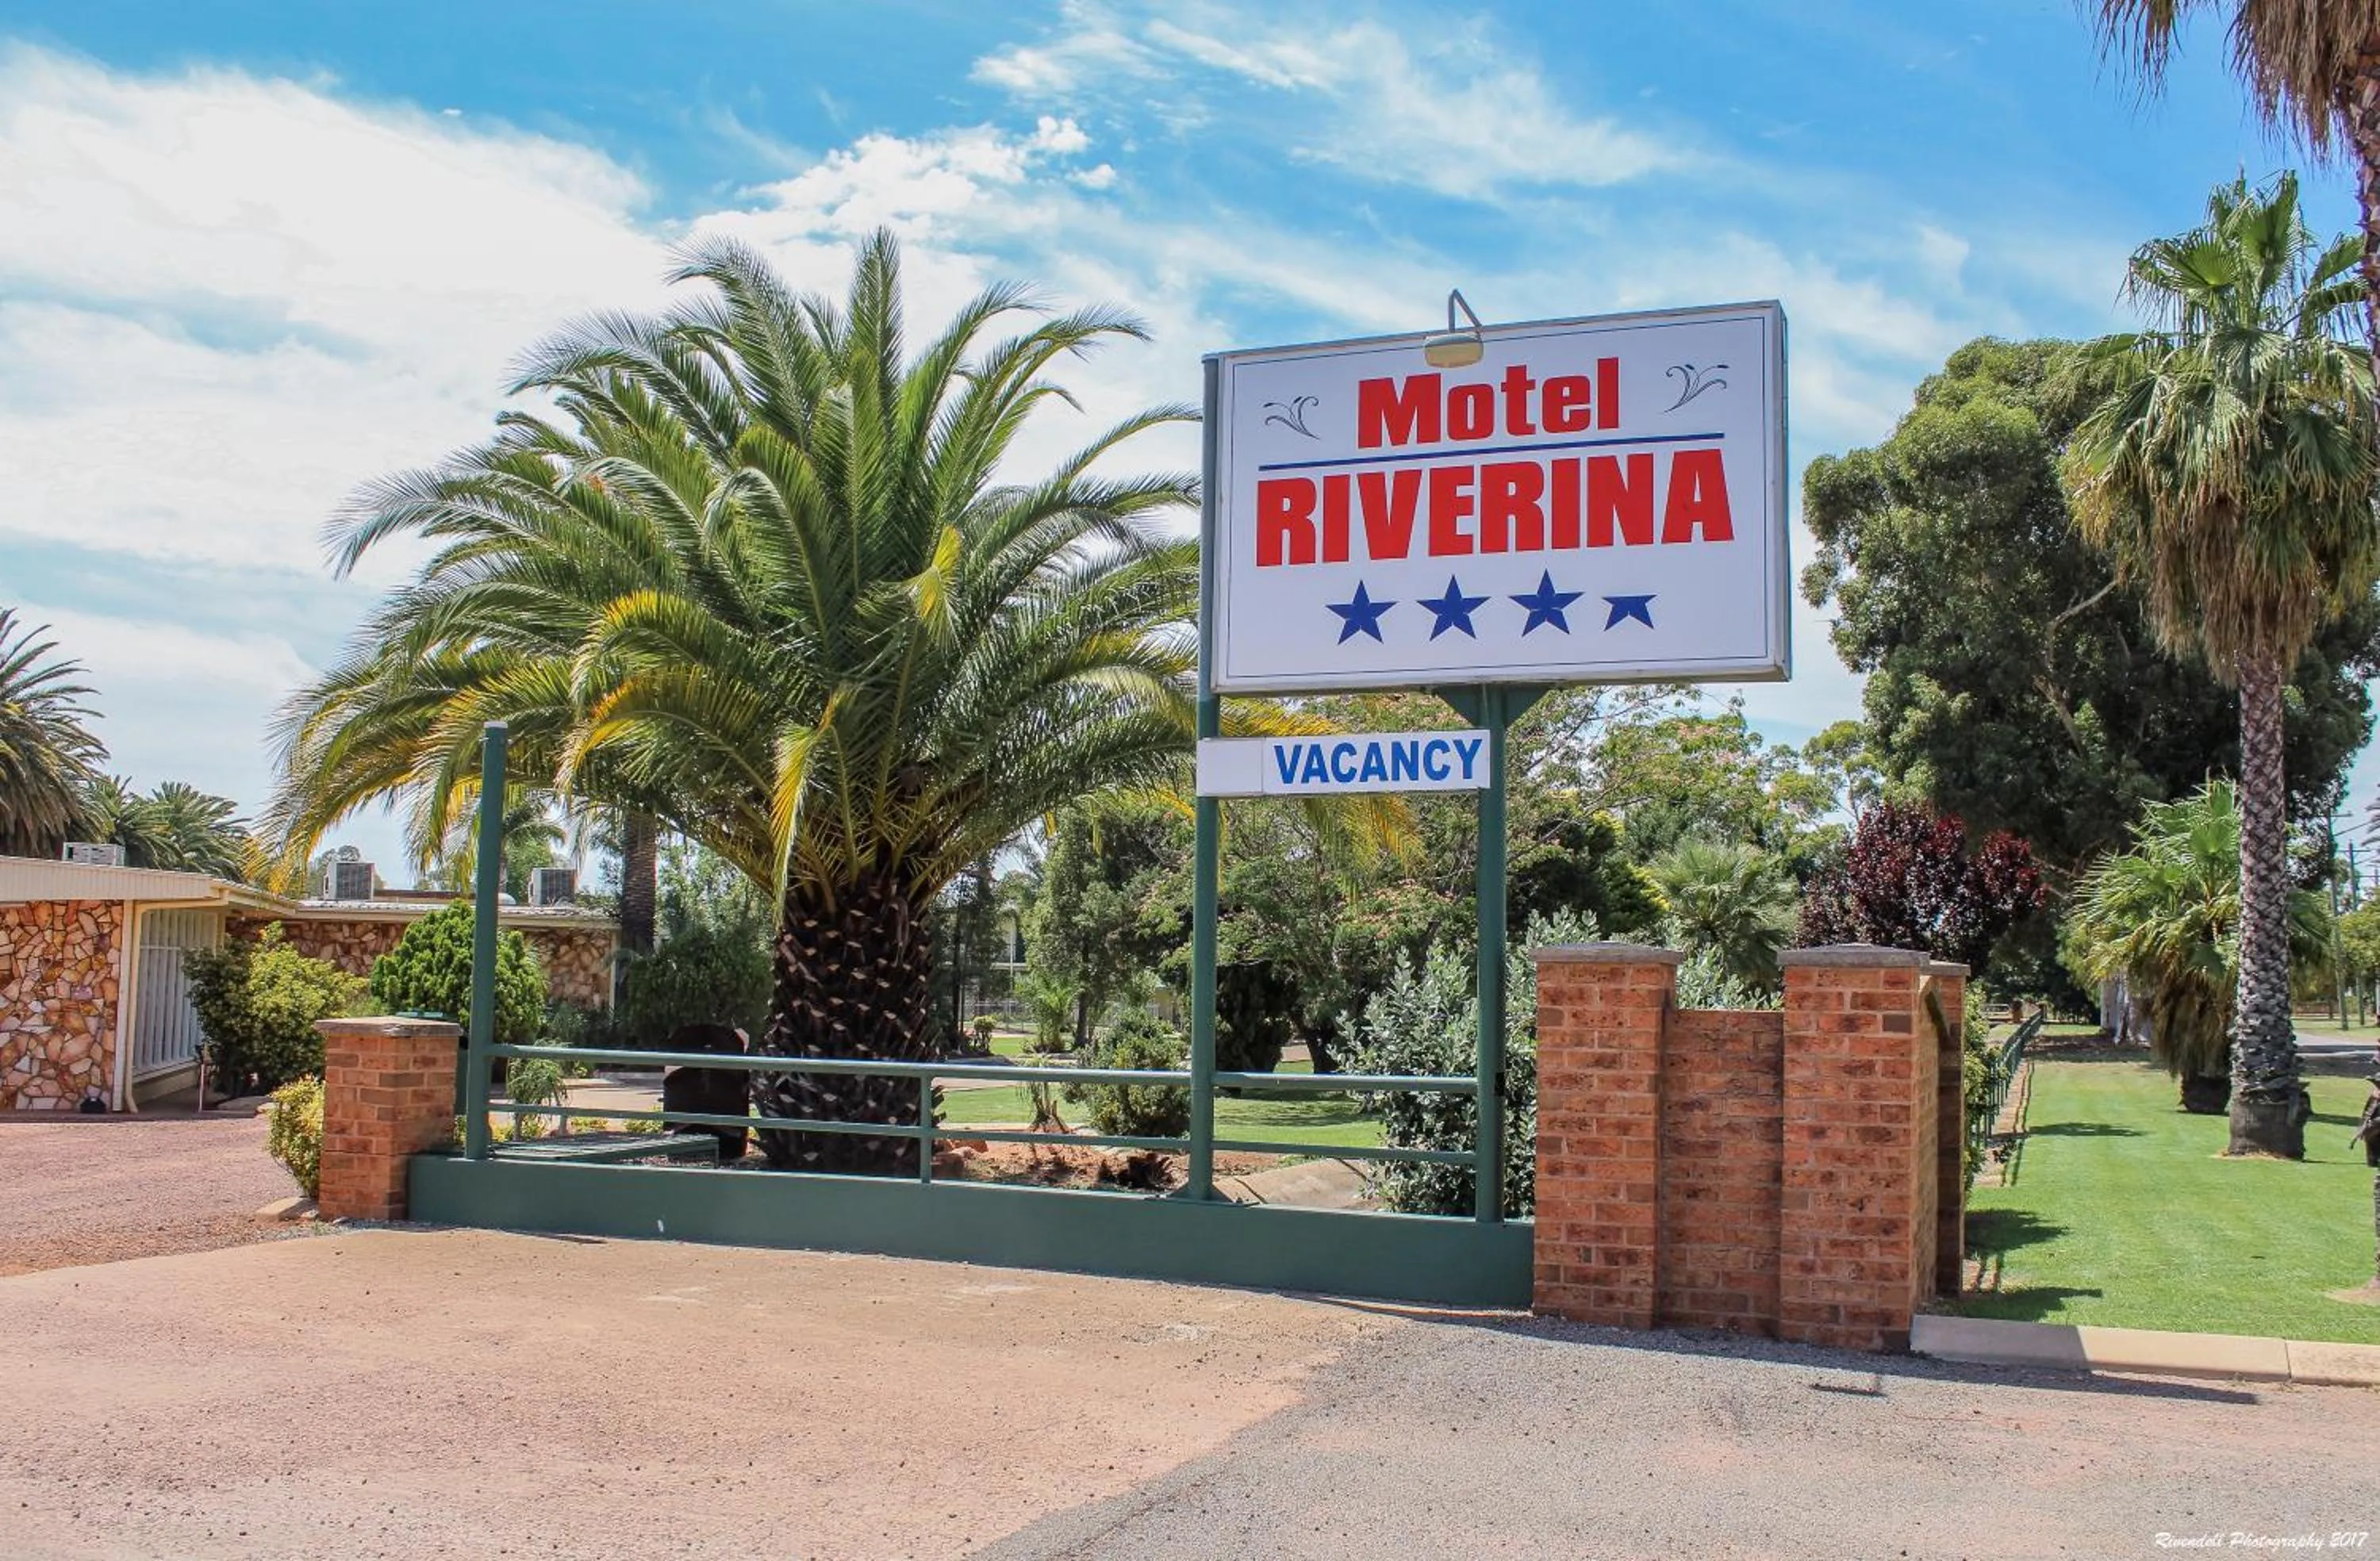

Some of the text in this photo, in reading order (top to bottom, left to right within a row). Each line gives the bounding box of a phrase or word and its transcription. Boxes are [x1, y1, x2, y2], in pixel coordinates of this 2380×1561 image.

[1357, 357, 1619, 449] Motel
[1256, 449, 1734, 567] RIVERINA
[1273, 738, 1483, 784] VACANCY
